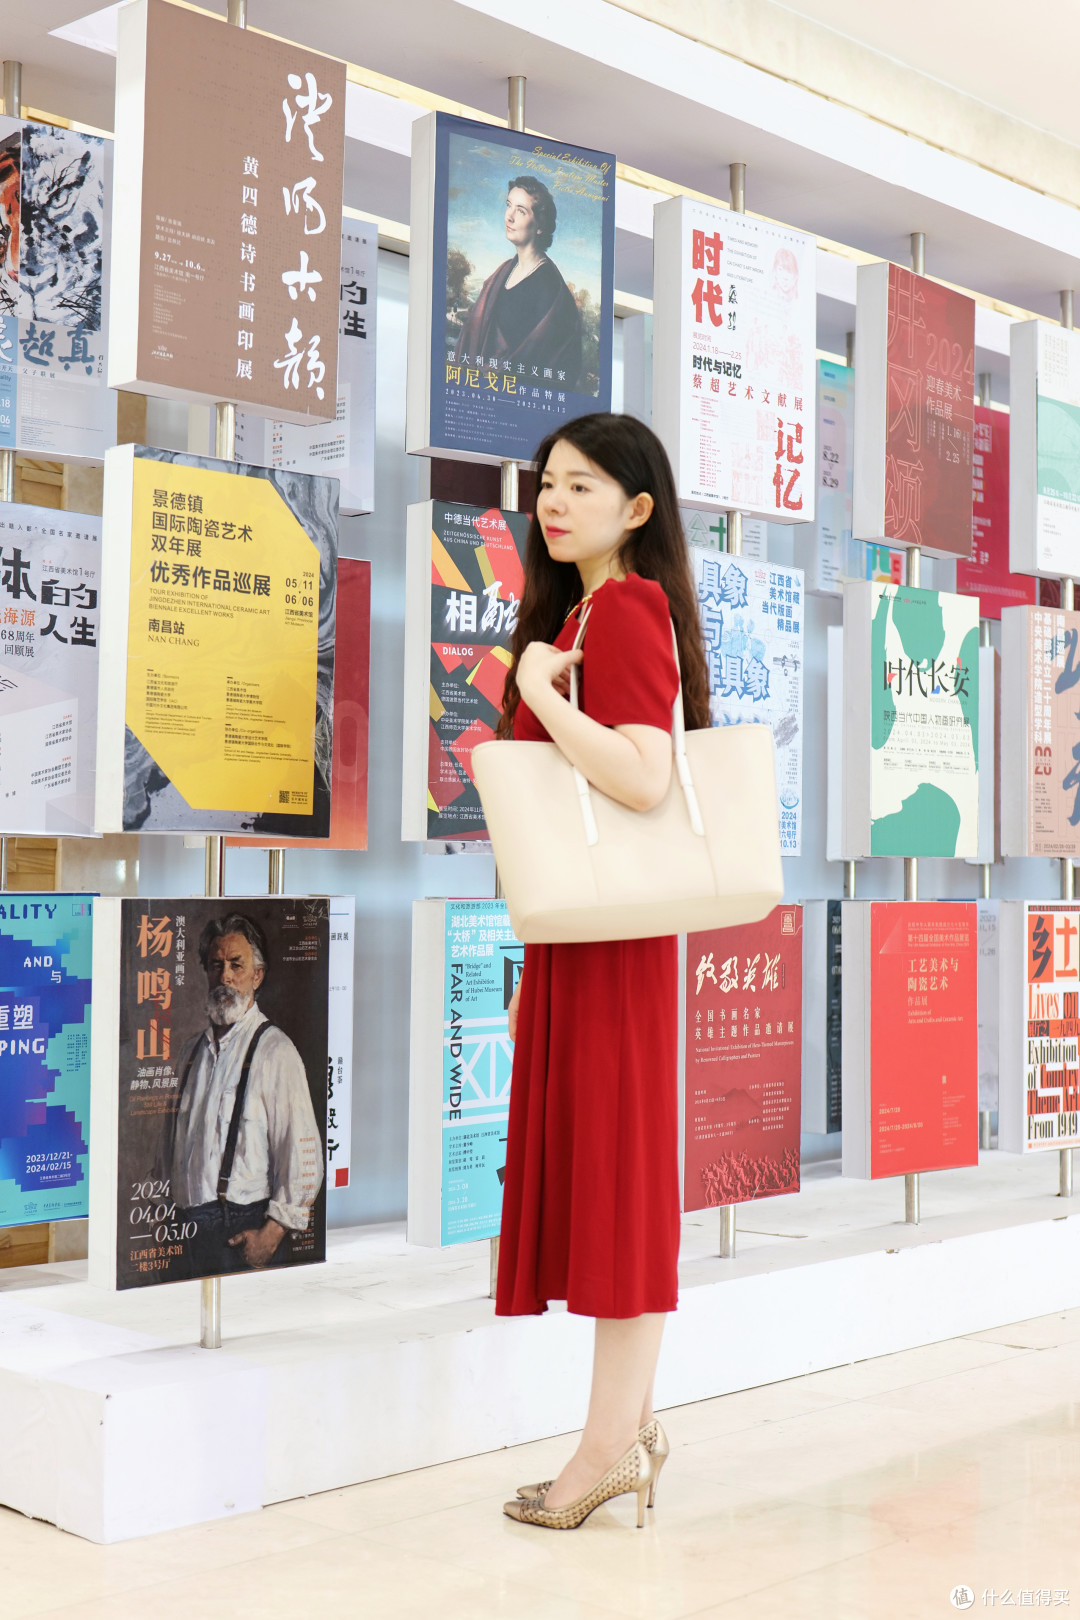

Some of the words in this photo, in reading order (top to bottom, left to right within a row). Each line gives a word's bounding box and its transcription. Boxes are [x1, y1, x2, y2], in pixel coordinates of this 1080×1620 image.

[509, 155, 523, 167] The
[526, 159, 552, 174] Italian
[585, 173, 609, 187] Master
[532, 146, 560, 160] Special
[561, 153, 598, 169] Exhibition
[600, 162, 612, 175] Of
[236, 155, 260, 381] 黄四德诗书画印展
[691, 228, 724, 328] 时代
[343, 309, 368, 340] 生
[18, 321, 95, 376] 超真
[925, 332, 976, 386] 2024
[446, 350, 566, 381] 意大利现实主义画家
[692, 354, 742, 379] 时代与记忆
[445, 364, 517, 394] 阿尼戈尼
[518, 385, 566, 403] 作品特展
[692, 373, 803, 412] 蔡超艺术文献展
[925, 373, 962, 402] 迎春美术
[925, 395, 953, 422] 作品展
[772, 417, 804, 511] 记忆
[152, 488, 204, 514] 景德镇
[152, 511, 253, 543] 国际陶瓷艺术
[443, 511, 507, 532] 中德当代艺术展
[151, 533, 202, 558] 双年展
[443, 529, 486, 541] ZEITGENÖSSISCHE
[486, 535, 503, 543] KUNST
[453, 537, 469, 545] CHINA
[480, 540, 514, 551] DEUTSCHLAND
[42, 564, 95, 579] 江西省美术馆1号厅
[150, 559, 271, 597] 优秀作品巡展
[768, 571, 793, 589] 江西省
[40, 578, 98, 610] 的
[149, 588, 167, 596] TOUR
[166, 590, 200, 600] EXHIBITION
[698, 559, 749, 610] 具象
[768, 586, 800, 605] 美术馆藏
[0, 607, 36, 627] 海源
[148, 603, 178, 612] BIENNALE
[178, 606, 212, 616] EXCELLENT
[213, 611, 234, 619] WORKS
[149, 596, 186, 606] JINGDEZHEN
[186, 600, 232, 611] INTERNATIONAL
[232, 605, 259, 615] CERAMIC
[258, 608, 271, 616] ART
[284, 608, 314, 619] 江西省美术馆
[761, 601, 793, 620] 当代版画
[39, 613, 97, 648] 人生
[148, 618, 185, 636] 南昌站
[776, 618, 800, 635] 精品展
[4, 643, 35, 658] 回顾展
[147, 635, 167, 644] NAN
[168, 636, 200, 647] CHANG
[442, 646, 474, 656] DIALOG
[883, 656, 970, 699] 时代长安
[781, 811, 797, 820] 2024
[481, 902, 494, 910] 2023
[451, 913, 511, 929] 湖北美术馆馆藏
[907, 933, 969, 943] 第十四届全国美术作品展览
[23, 955, 53, 968] AND
[174, 915, 186, 986] 澳大利亚画家
[450, 943, 494, 958] 艺术作品展
[465, 970, 482, 978] Related
[695, 951, 781, 996] 致敬英雄
[907, 957, 959, 973] 工艺美术与
[50, 969, 62, 984] 与
[450, 963, 463, 1004] FAR
[907, 975, 949, 992] 陶瓷艺术
[136, 914, 173, 1064] 杨鸣山
[907, 995, 928, 1007] 作品展
[1028, 982, 1060, 1020] Lives
[1063, 991, 1079, 1020] on
[695, 1006, 761, 1023] 全国书画名家
[449, 1008, 463, 1059] AND
[694, 1020, 794, 1041] 英雄主题作品邀请展
[1028, 1037, 1077, 1065] Exhibition
[129, 1077, 179, 1091] 静物、风景展
[1027, 1064, 1038, 1090] of
[1040, 1063, 1079, 1089] Country
[449, 1063, 462, 1121] WIDE
[1027, 1089, 1061, 1115] Theme
[1027, 1114, 1054, 1140] From
[1057, 1112, 1078, 1137] 1949
[25, 1161, 72, 1174] 2024/02/15
[130, 1179, 171, 1201] 2024
[129, 1202, 177, 1225] 04.04
[129, 1244, 184, 1261] 江西省美术馆
[130, 1257, 171, 1273] 二楼3号厅
